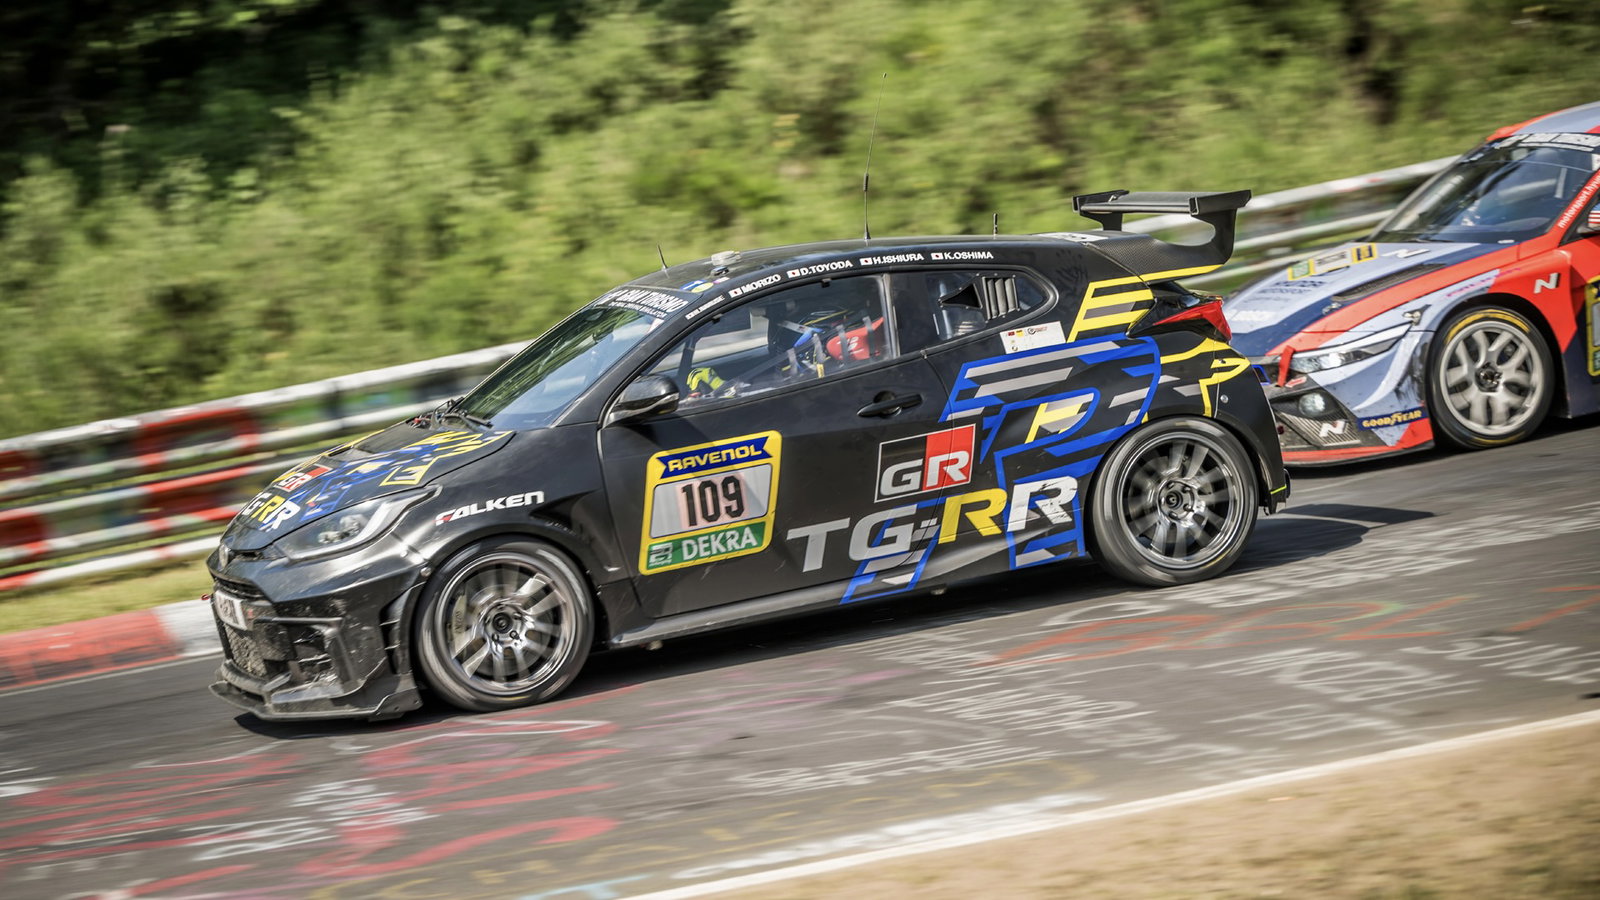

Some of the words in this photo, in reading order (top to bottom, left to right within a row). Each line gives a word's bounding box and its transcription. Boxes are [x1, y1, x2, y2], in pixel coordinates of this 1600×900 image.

[1557, 172, 1600, 229] motorsport.hyu
[872, 252, 924, 265] H.ISHIURA
[944, 251, 994, 260] K.OSHIMA
[800, 260, 853, 276] D.TOYODA
[740, 273, 781, 293] MORIZO
[1533, 272, 1561, 294] N
[1319, 419, 1346, 437] N
[1362, 410, 1422, 427] GOODYEAR
[667, 444, 762, 472] RAVENOL
[880, 447, 970, 493] GR
[435, 490, 544, 526] FALKEN
[681, 475, 745, 527] 109
[681, 526, 758, 561] DEKRA
